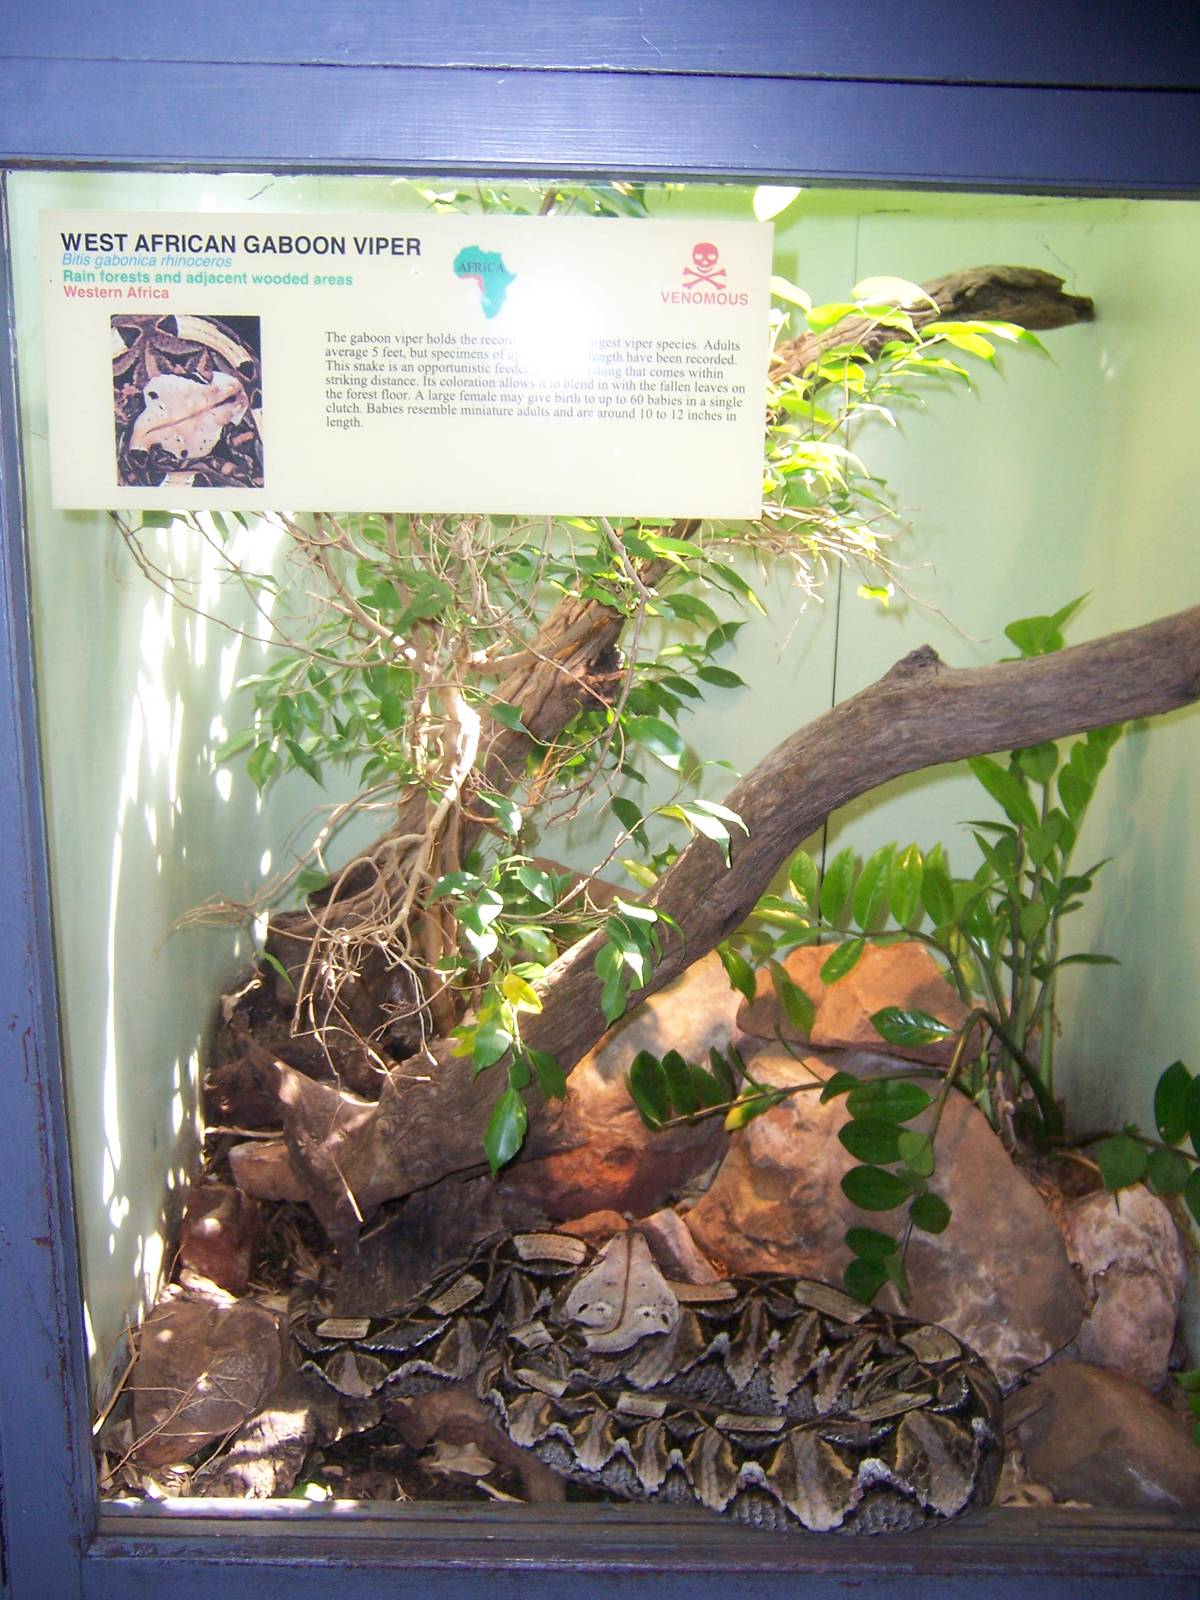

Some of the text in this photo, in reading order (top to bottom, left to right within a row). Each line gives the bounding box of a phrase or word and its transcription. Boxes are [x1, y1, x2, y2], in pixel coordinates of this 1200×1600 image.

[61, 232, 422, 256] WEST AFRICAN GABOON VIPER
[62, 253, 232, 269] Bitis gabonica rhinoceros
[458, 262, 504, 273] AFRICA
[64, 270, 352, 287] Rain forests and adjacent wooded areas
[64, 287, 169, 299] Western Africa
[661, 291, 749, 305] VENOMOUS
[326, 332, 346, 343] The
[350, 332, 390, 345] gaboon
[395, 333, 423, 346] viper
[427, 333, 456, 344] holds
[460, 334, 476, 345] the
[625, 339, 653, 351] viper
[656, 340, 699, 352] species.
[704, 339, 740, 351] Adults
[325, 348, 368, 359] average
[372, 347, 379, 356] 5
[383, 347, 406, 358] feet,
[410, 348, 428, 357] but
[431, 348, 488, 360] specimens
[493, 348, 504, 359] of
[626, 352, 653, 363] have
[656, 353, 682, 363] been
[686, 354, 737, 365] recorded.
[326, 360, 350, 371] This
[354, 361, 385, 371] snake
[389, 362, 398, 372] is
[401, 364, 414, 372] an
[418, 362, 490, 375] opportunistic
[625, 367, 646, 377] that
[688, 369, 724, 379] within
[326, 374, 367, 387] striking
[371, 375, 419, 386] distance.
[423, 376, 436, 386] Its
[440, 377, 495, 387] coloration
[499, 378, 535, 388] allows
[564, 379, 594, 390] blend
[598, 380, 608, 390] in
[612, 380, 636, 390] with
[640, 381, 657, 391] the
[660, 381, 691, 392] fallen
[695, 382, 728, 393] leaves
[732, 385, 745, 393] on
[326, 389, 342, 399] the
[347, 389, 377, 399] forest
[382, 390, 410, 400] floor.
[415, 391, 424, 400] A
[428, 391, 456, 403] large
[459, 392, 496, 402] female
[500, 394, 523, 404] may
[528, 392, 551, 405] give
[555, 392, 581, 403] birth
[584, 394, 595, 404] to
[599, 397, 612, 406] up
[616, 395, 627, 404] to
[630, 395, 644, 404] 60
[648, 395, 683, 405] babies
[687, 396, 696, 406] in
[710, 397, 743, 409] single
[326, 403, 362, 413] clutch.
[367, 404, 404, 414] Babies
[408, 404, 457, 415] resemble
[461, 406, 513, 416] miniature
[517, 406, 550, 417] adults
[554, 407, 574, 417] and
[597, 408, 635, 418] around
[640, 409, 653, 419] 10
[656, 410, 667, 419] to
[672, 409, 683, 420] 12
[688, 410, 722, 421] inches
[726, 412, 736, 421] in
[327, 418, 364, 430] length.
